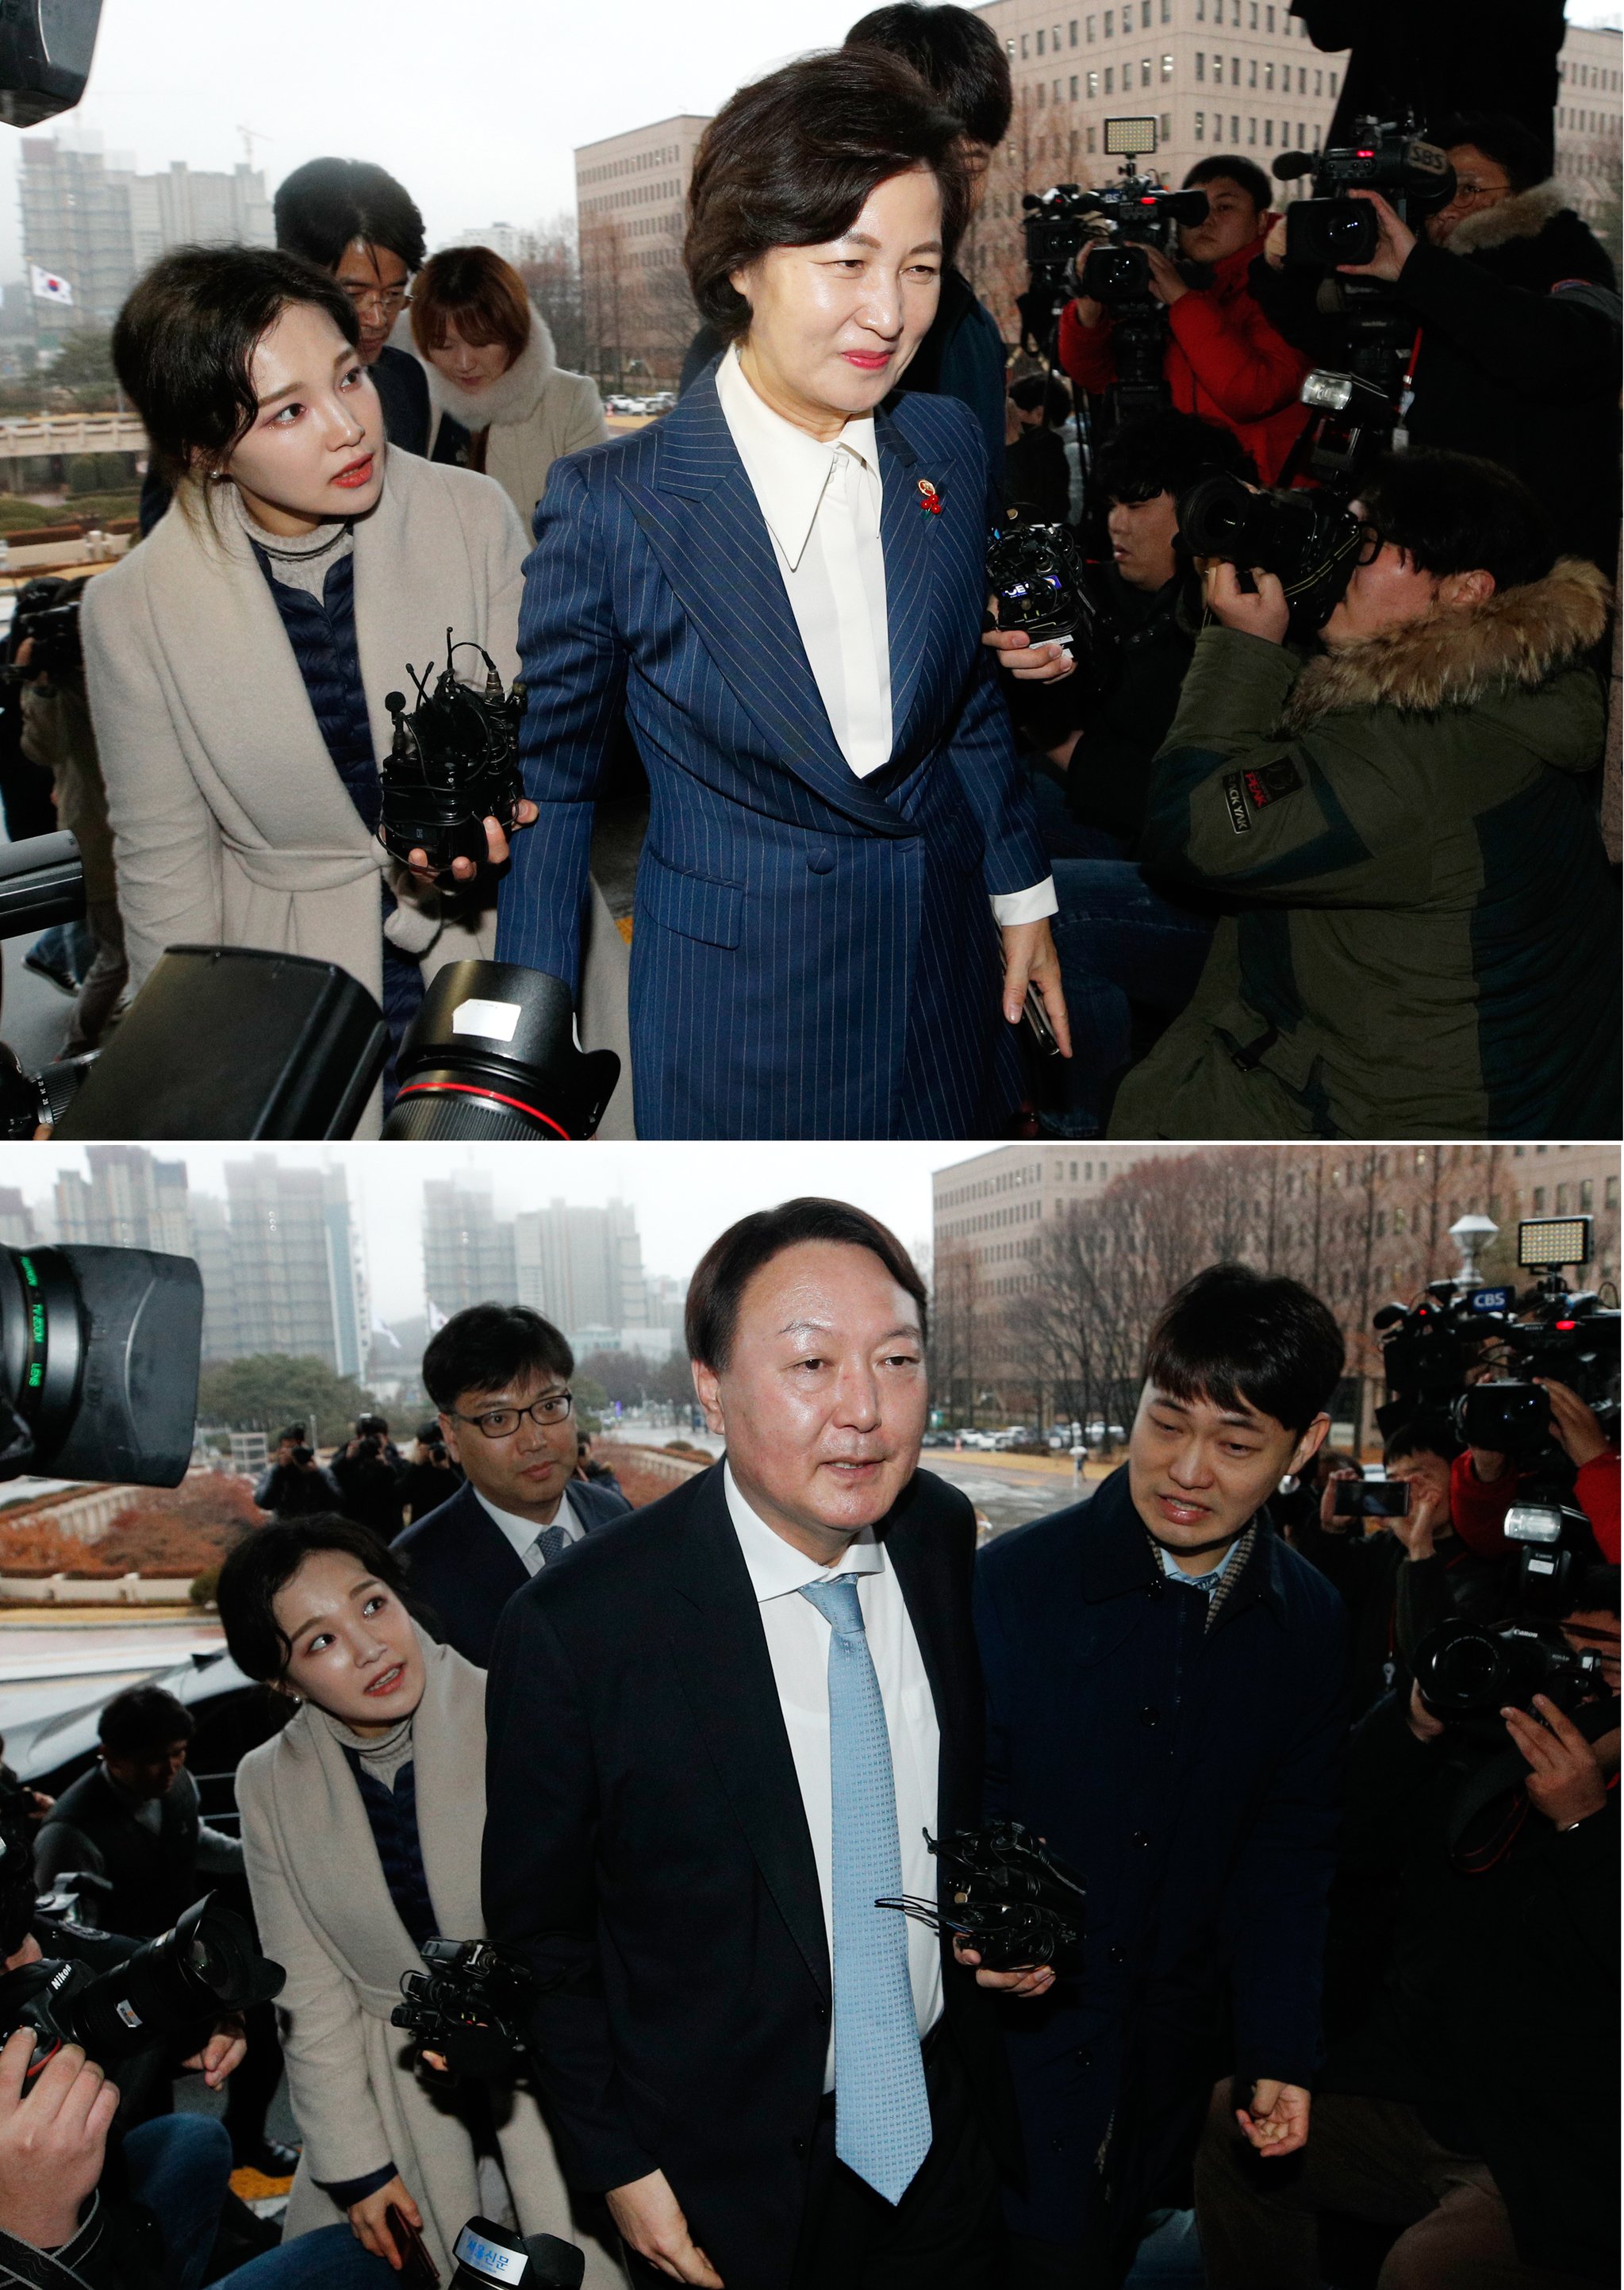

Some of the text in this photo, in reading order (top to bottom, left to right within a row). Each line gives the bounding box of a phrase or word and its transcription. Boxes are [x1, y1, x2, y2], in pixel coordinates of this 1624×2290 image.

[1412, 144, 1442, 170] SBS
[1233, 805, 1248, 830] YAK
[41, 1097, 50, 1106] 28
[1473, 1292, 1506, 1308] CBS
[28, 1362, 44, 1388] LENS
[1513, 1628, 1538, 1639] Canon
[51, 1963, 72, 1990] Nikon
